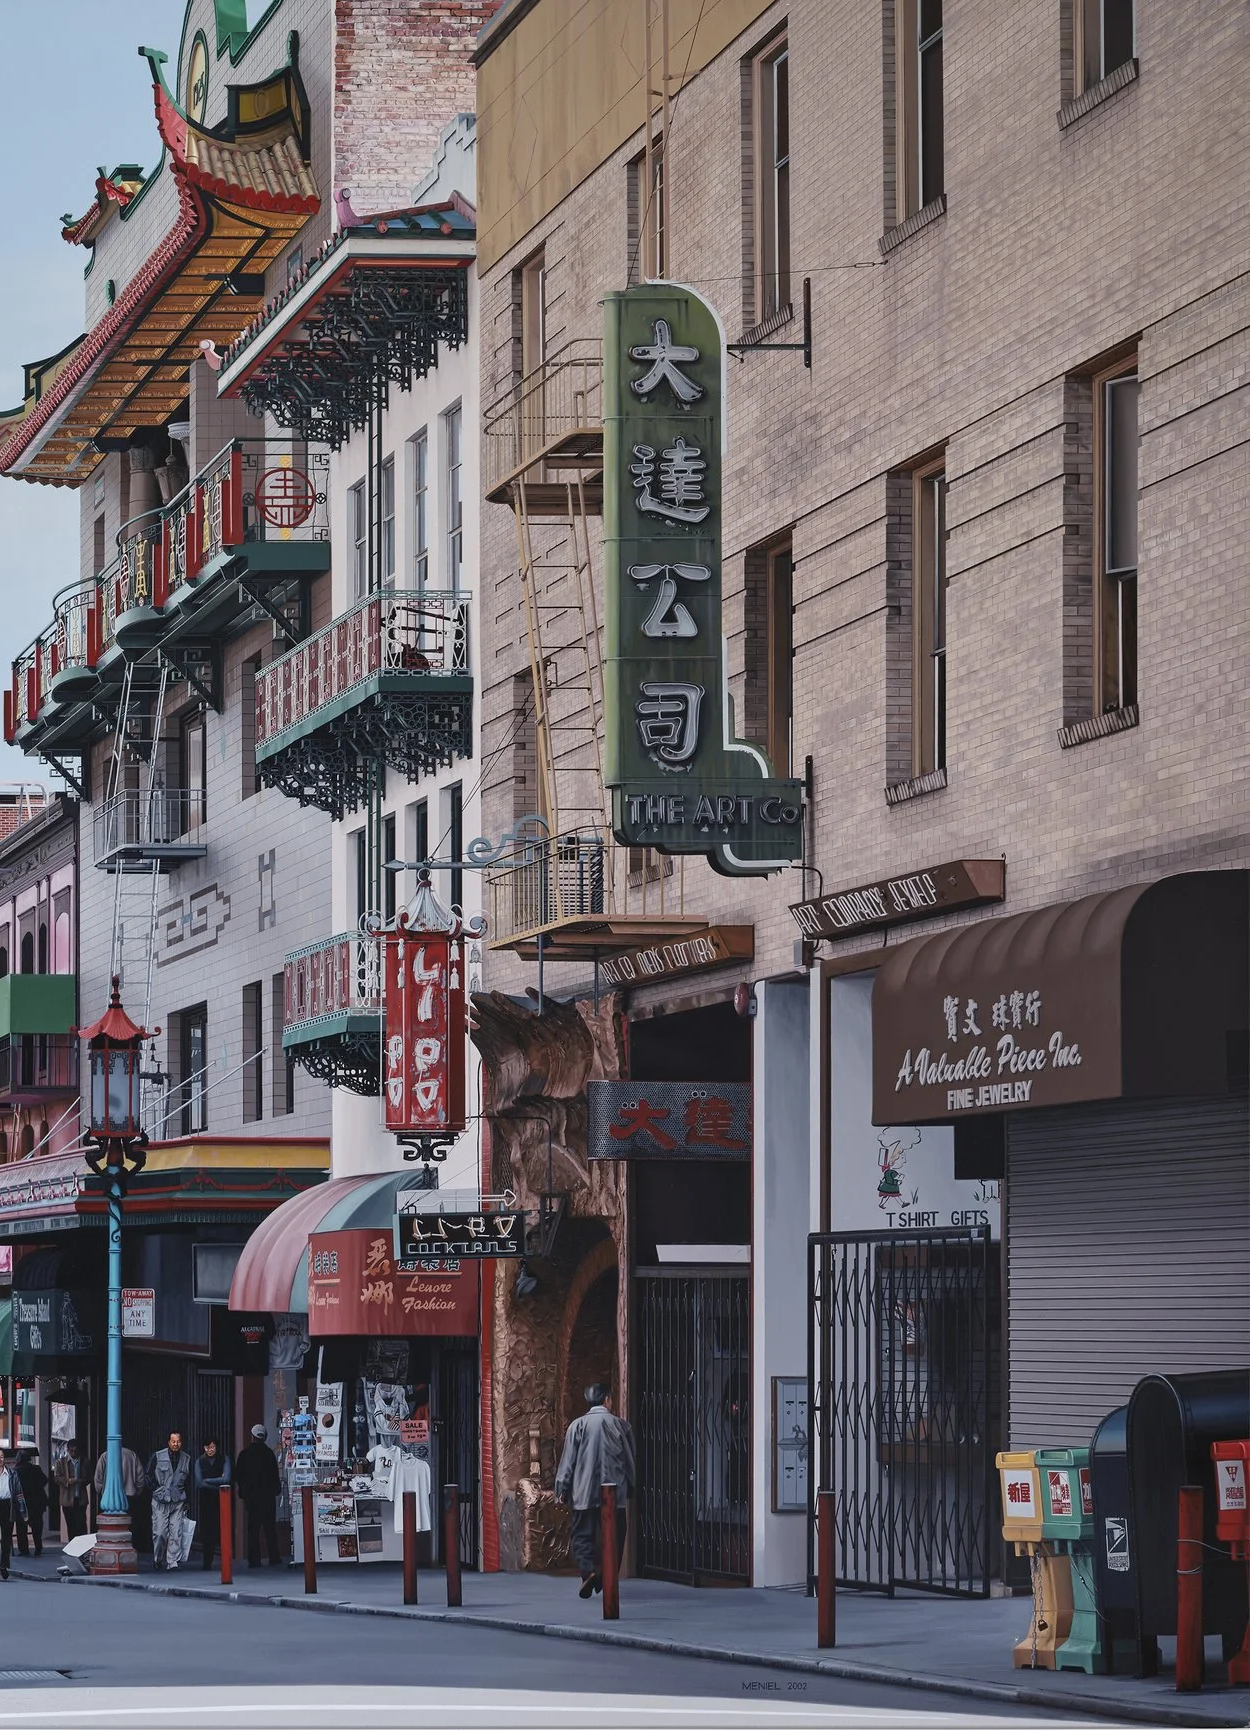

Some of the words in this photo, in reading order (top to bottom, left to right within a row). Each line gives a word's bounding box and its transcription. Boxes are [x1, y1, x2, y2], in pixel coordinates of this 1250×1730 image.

[627, 318, 711, 762] 大達公司
[625, 794, 685, 824] THE
[692, 794, 754, 824] ART
[759, 796, 800, 823] Co
[792, 904, 823, 936] ART
[895, 1049, 913, 1092] A
[911, 1045, 992, 1086] Valuable
[996, 1033, 1048, 1076] Piece
[1048, 1031, 1083, 1068] Inc.
[947, 1089, 974, 1111] FINE
[975, 1080, 1033, 1105] JEWELRY
[608, 1097, 751, 1152] 大達
[886, 1213, 897, 1228] T
[899, 1211, 940, 1227] SHIRT
[951, 1210, 990, 1226] GIFTS
[406, 1276, 453, 1293] Lenore
[130, 1310, 145, 1318] ANY
[401, 1296, 457, 1314] Fashion
[129, 1319, 147, 1328] TIME
[742, 1681, 782, 1691] MENIEL
[787, 1681, 807, 1691] 2002
